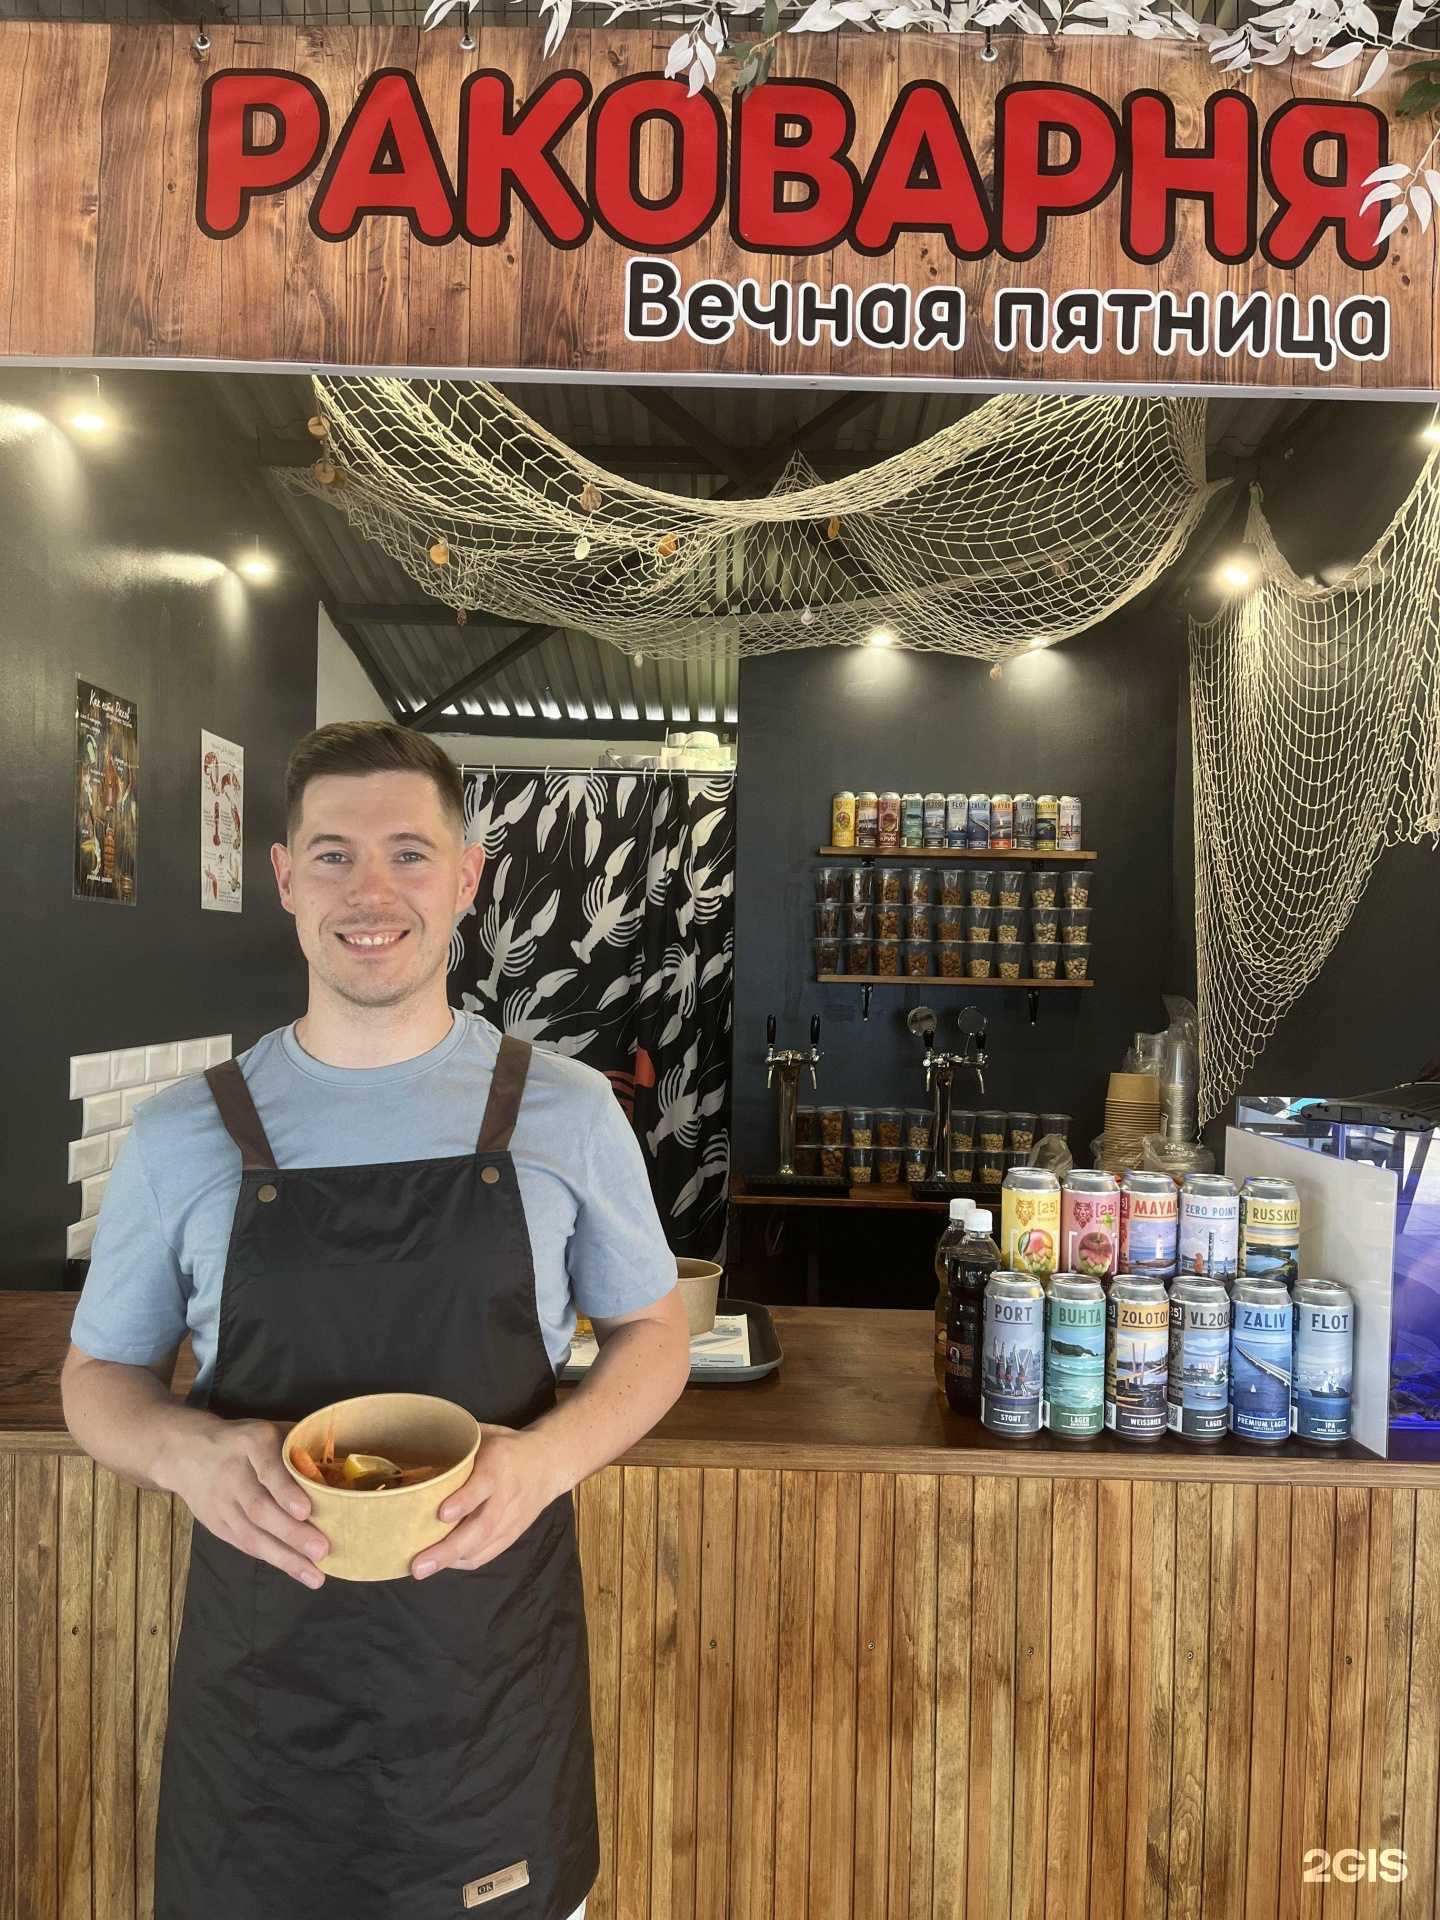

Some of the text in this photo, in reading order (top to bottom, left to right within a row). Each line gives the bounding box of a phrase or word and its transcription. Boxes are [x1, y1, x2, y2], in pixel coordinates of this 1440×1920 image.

[195, 67, 1390, 270] РАКОВАРНЯ
[624, 257, 1390, 371] Вечная пятница
[1095, 1202, 1117, 1218] [25]
[1185, 1203, 1208, 1216] ZERO
[1212, 1206, 1237, 1218] POINT
[1252, 1207, 1298, 1222] RUSSKIY
[994, 1304, 1033, 1321] PORT
[1059, 1307, 1101, 1324] BUHTA
[1244, 1310, 1286, 1329] ZALIV
[1311, 1313, 1349, 1330] FLOT
[1000, 1413, 1022, 1423] STOUT
[1237, 1416, 1288, 1428] PREMIUM LAGER
[1325, 1421, 1336, 1429] IPA
